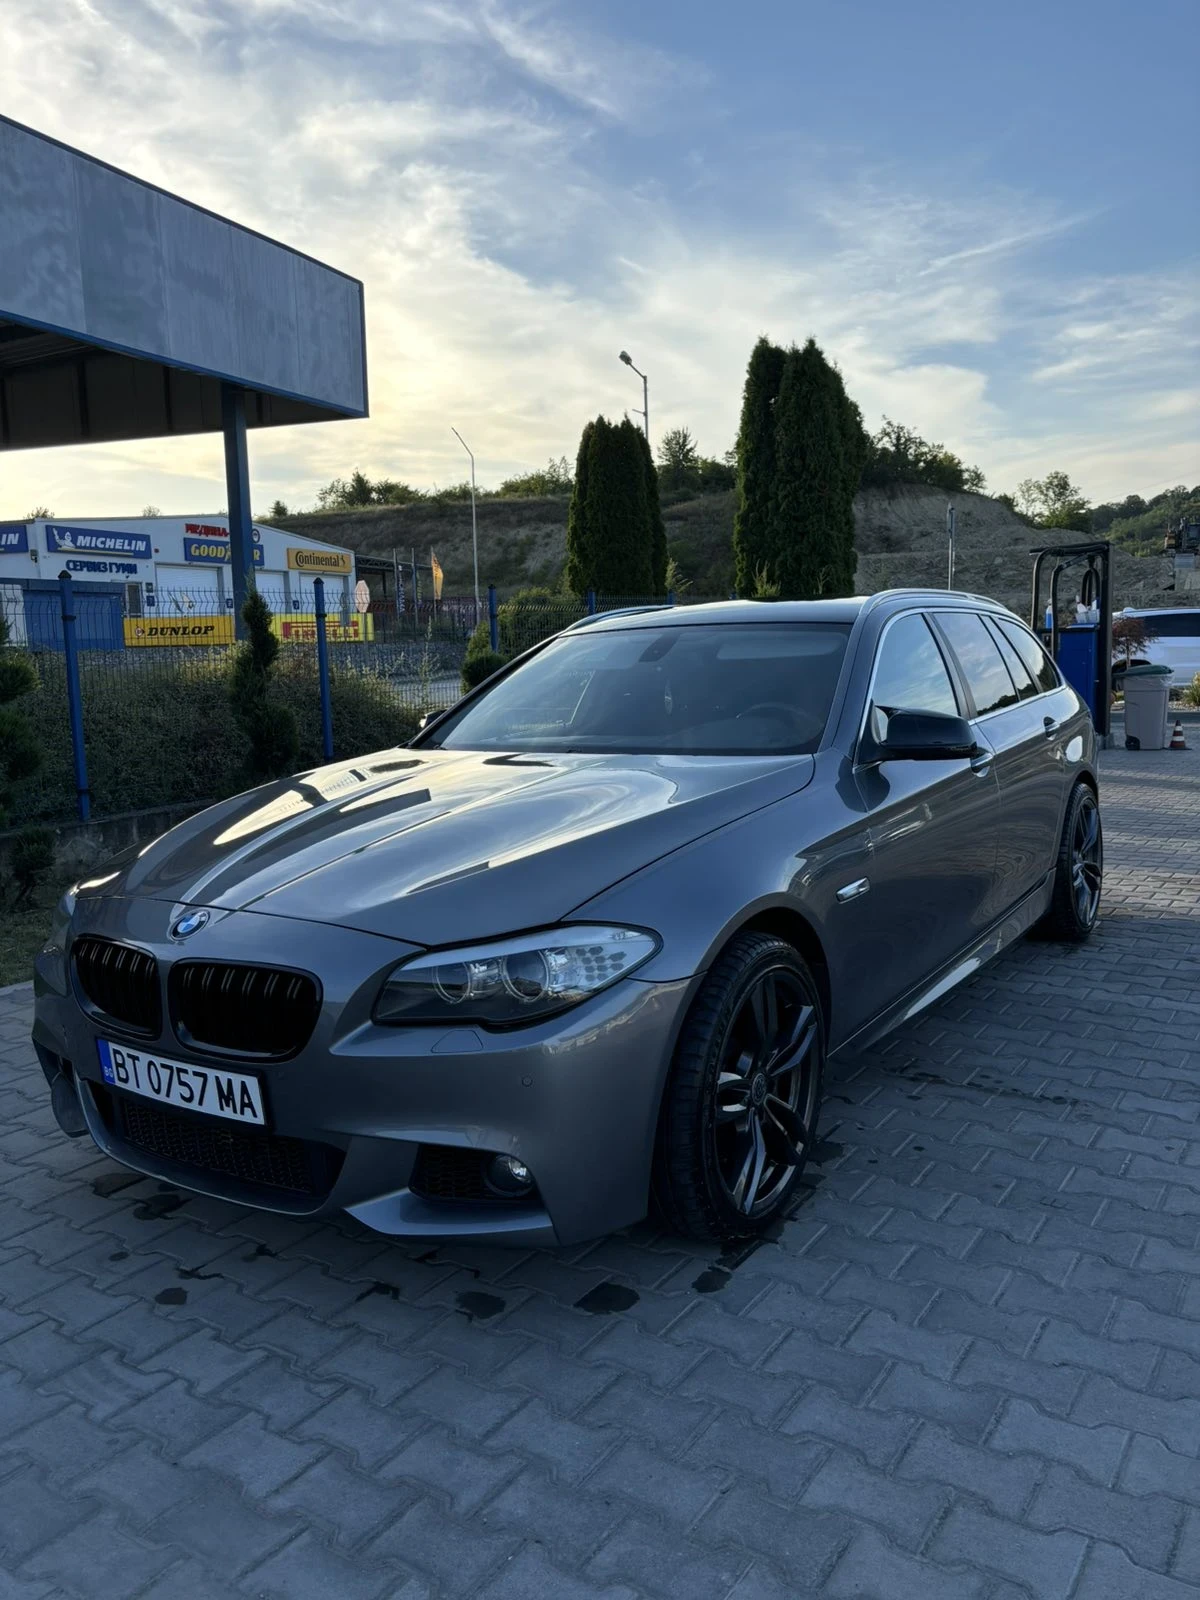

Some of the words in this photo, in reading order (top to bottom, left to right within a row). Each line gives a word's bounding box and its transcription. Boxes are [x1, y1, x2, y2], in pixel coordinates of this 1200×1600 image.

[76, 535, 147, 551] MICHELIN
[190, 544, 261, 561] GOODR
[295, 551, 340, 567] Continental
[66, 560, 108, 572] СЕРВИЗ
[147, 625, 215, 637] DUNLOP
[112, 1047, 140, 1089] BT
[147, 1060, 208, 1107] 0757
[215, 1075, 258, 1119] MA
